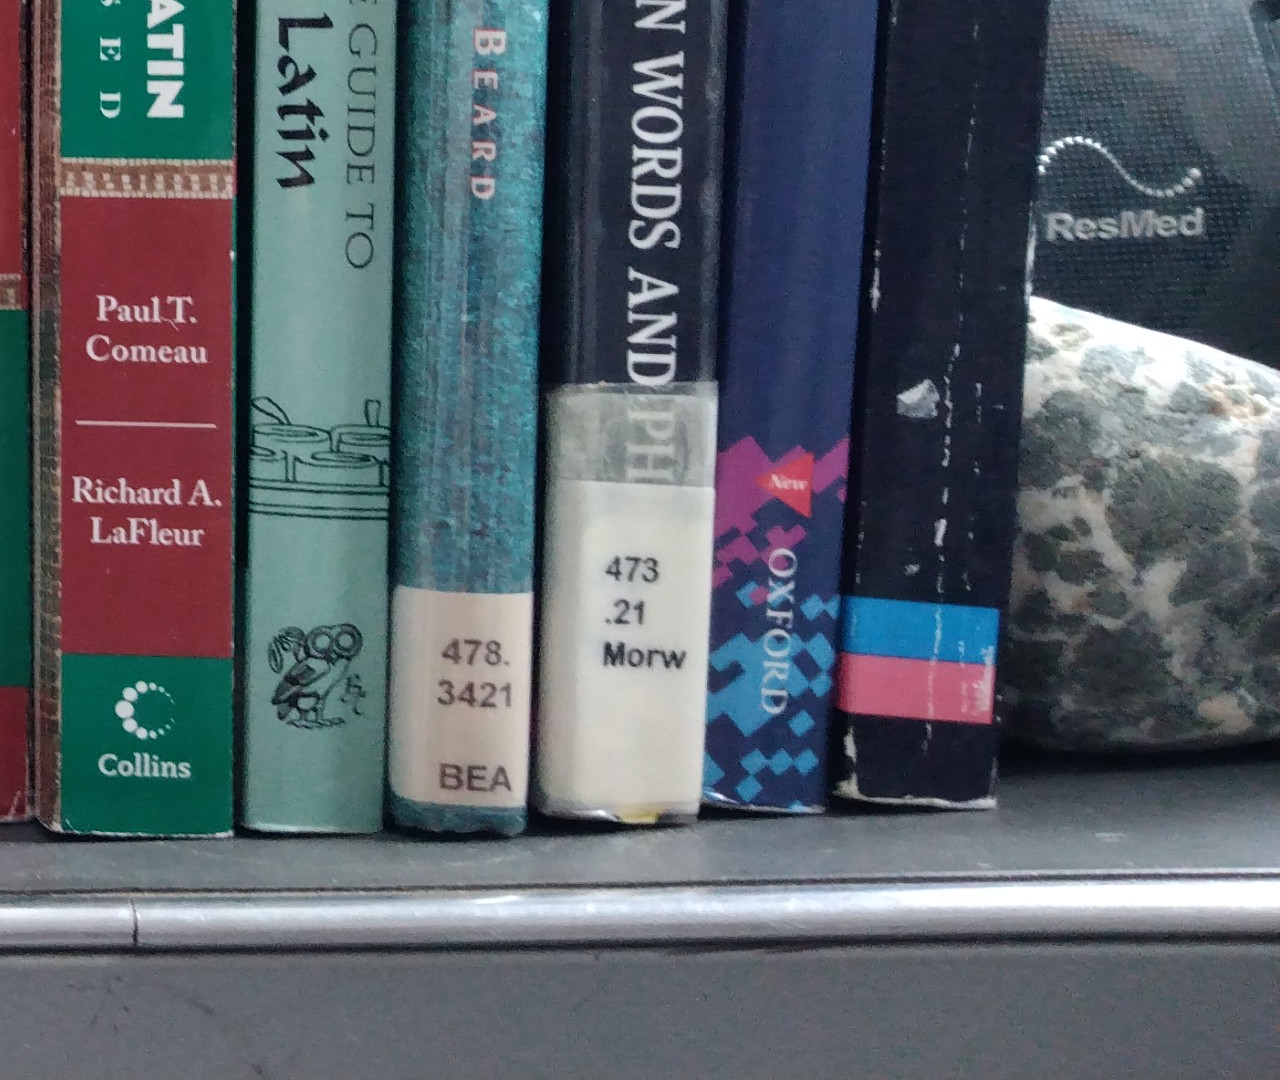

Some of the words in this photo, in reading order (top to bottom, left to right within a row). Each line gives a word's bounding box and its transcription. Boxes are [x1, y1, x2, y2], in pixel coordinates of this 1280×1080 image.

[275, 11, 334, 189] Latin
[346, 22, 378, 186] GUIDE
[469, 25, 507, 201] BEARD
[627, 50, 685, 251] WORDS
[345, 202, 375, 269] TO
[1046, 206, 1206, 242] ResMed
[96, 294, 160, 323] Paul
[161, 297, 197, 323] T.
[626, 265, 680, 388] AND
[85, 334, 209, 365] Comeau
[72, 476, 181, 506] Richard
[189, 479, 222, 508] A.
[768, 471, 809, 493] New
[90, 516, 205, 548] LaFleur
[604, 556, 660, 584] 473
[604, 598, 646, 625] .21
[761, 547, 798, 715] OXFORD
[441, 637, 511, 667] 478.
[602, 640, 687, 670] Morw
[436, 679, 513, 709] 3421
[98, 753, 192, 780] Collins
[438, 762, 513, 793] BEA
